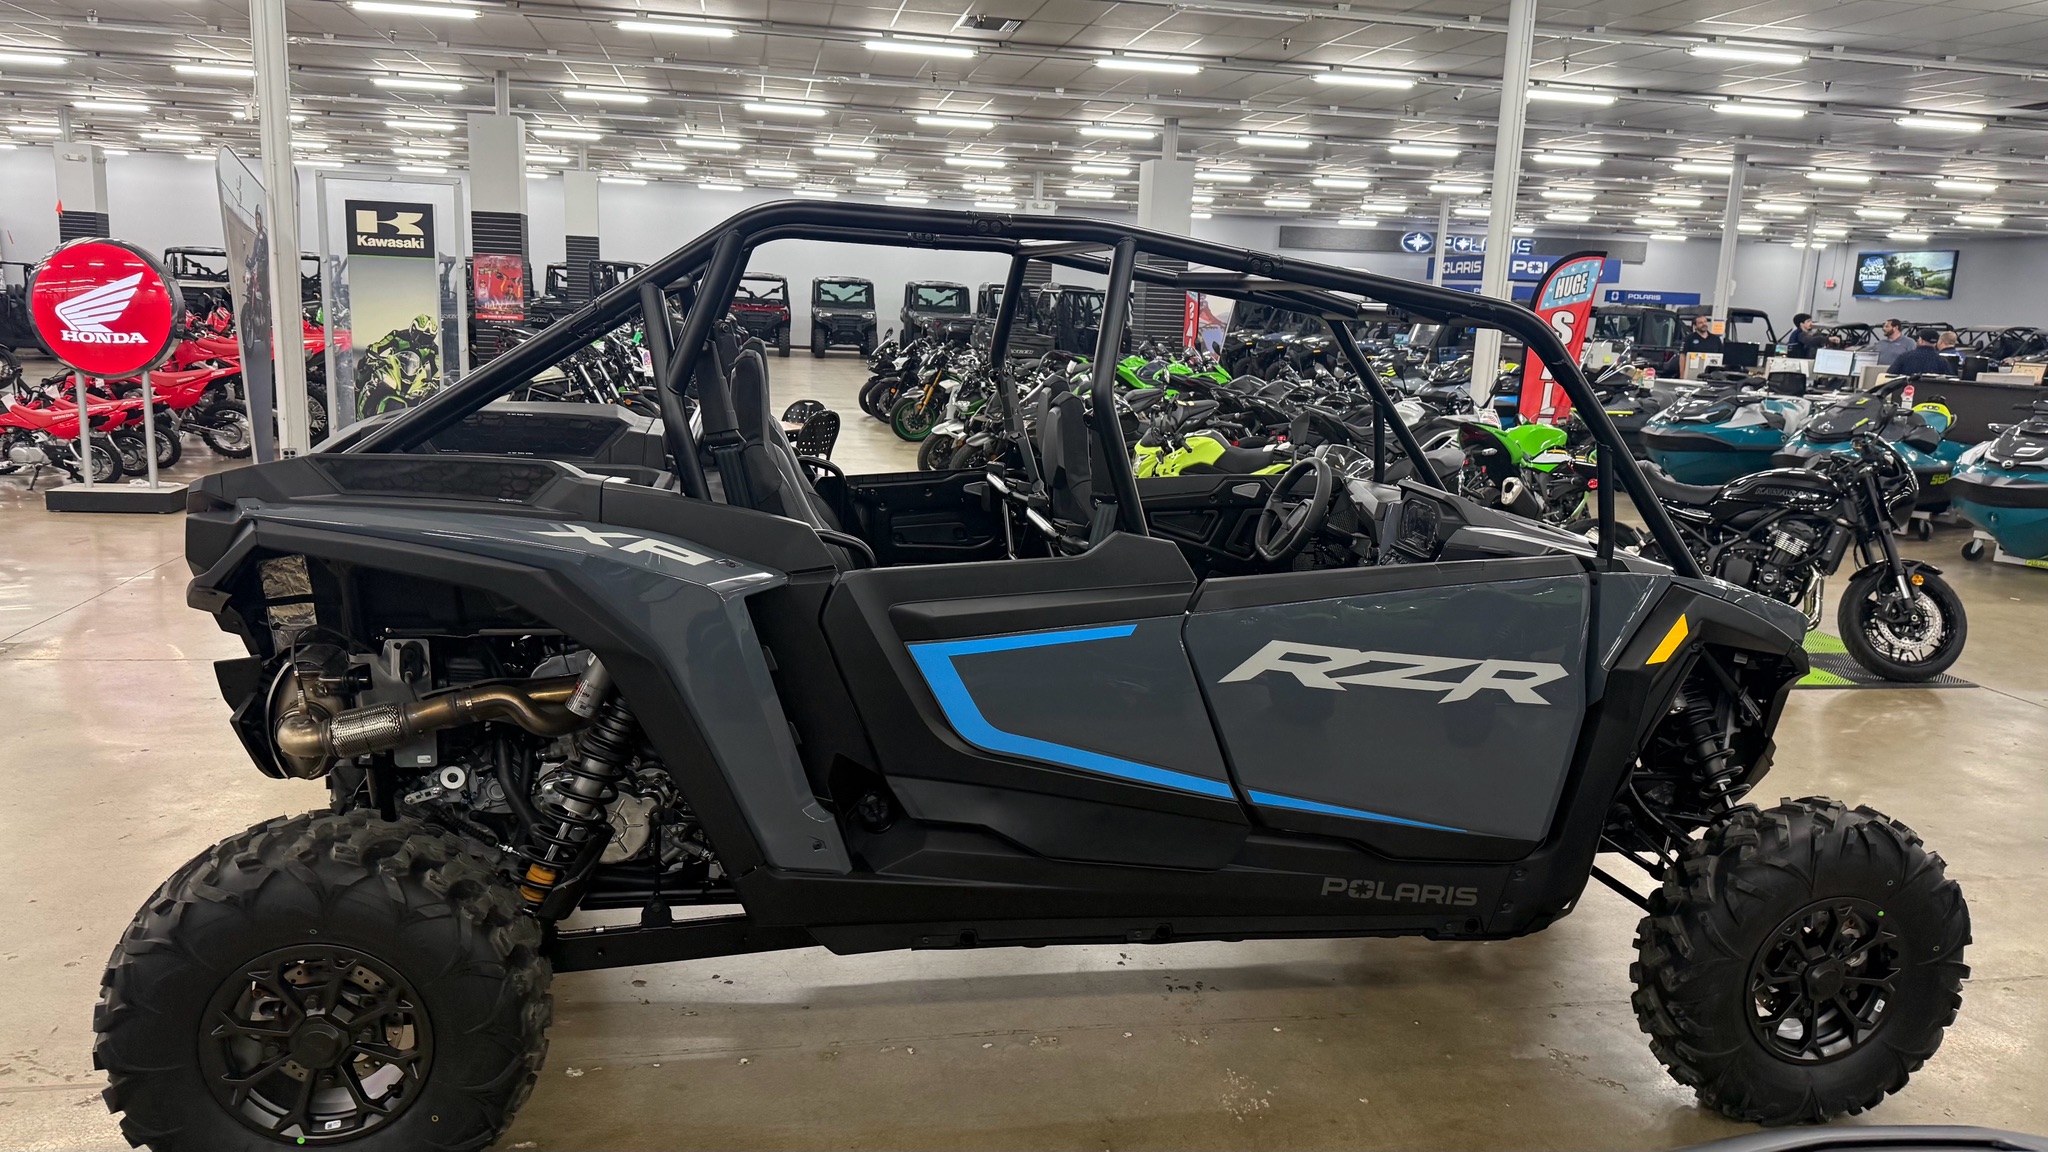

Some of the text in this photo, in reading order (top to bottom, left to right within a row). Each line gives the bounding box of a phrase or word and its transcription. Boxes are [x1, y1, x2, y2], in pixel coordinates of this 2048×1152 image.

[356, 234, 425, 249] Kawasaki
[1443, 260, 1482, 274] OLARIS
[1554, 271, 1590, 299] HUGE
[1627, 293, 1662, 301] POLARIS
[60, 329, 149, 345] HONDA
[527, 523, 715, 566] XP
[1217, 639, 1570, 705] RZR
[1320, 877, 1478, 906] POLARIS
